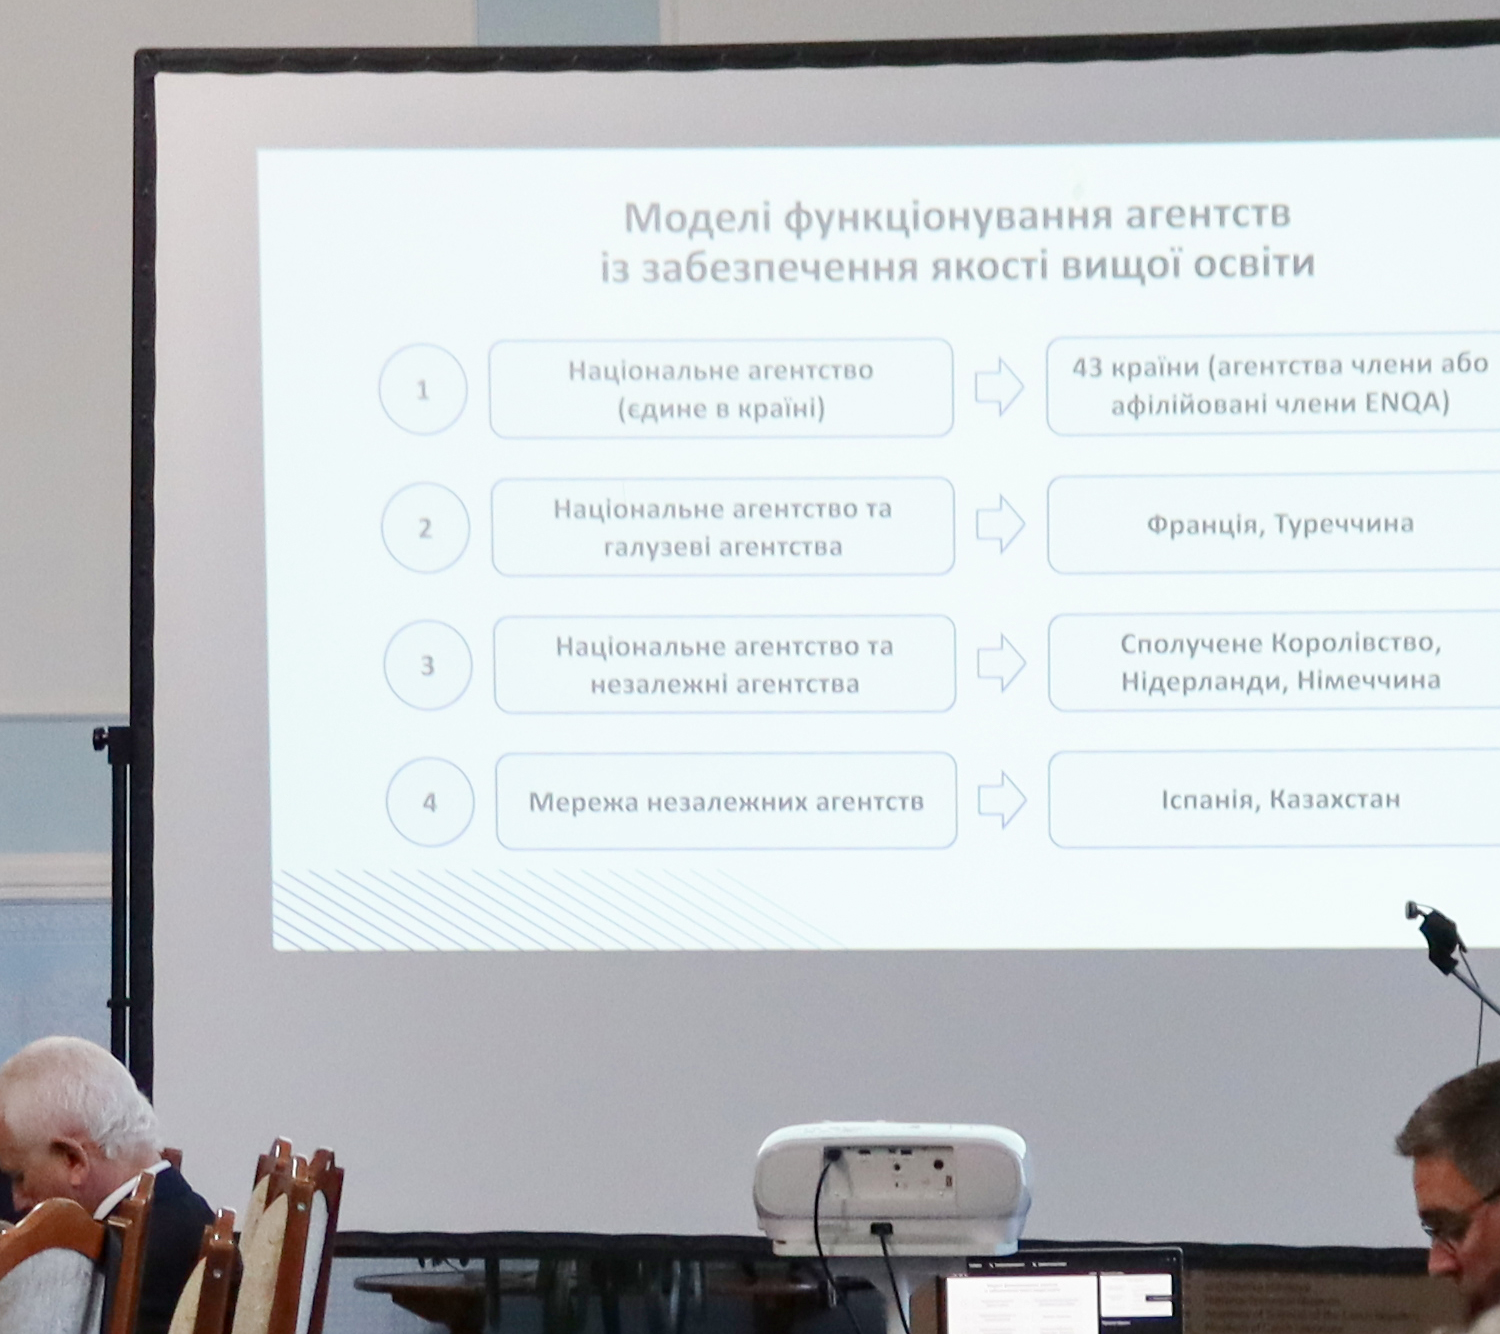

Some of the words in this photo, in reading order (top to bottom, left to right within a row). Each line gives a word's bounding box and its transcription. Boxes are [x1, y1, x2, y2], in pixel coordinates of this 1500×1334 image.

[625, 200, 771, 241] Моделі
[784, 199, 1113, 241] функціонування
[1126, 203, 1291, 230] агентств
[601, 250, 630, 284] із
[643, 249, 918, 283] забезпечення
[932, 248, 1048, 281] якості
[1062, 247, 1183, 287] вищої
[1193, 245, 1315, 279] освіти
[568, 359, 740, 386] Національне
[747, 363, 874, 381] агентство
[1072, 356, 1103, 379] 43
[1111, 354, 1199, 383] країни
[1208, 354, 1343, 382] (агентства
[1351, 358, 1433, 375] члени
[1441, 350, 1489, 374] або
[417, 379, 429, 401] 1
[617, 396, 708, 424] (єдине
[716, 403, 730, 419] в
[737, 395, 826, 424] країні)
[1111, 392, 1268, 421] афілійовані
[1275, 397, 1357, 414] члени
[1365, 389, 1450, 417] ENQA)
[553, 497, 725, 524] Національне
[732, 502, 859, 519] агентство
[866, 502, 892, 519] та
[418, 517, 432, 539] 2
[1146, 513, 1265, 541] Франція,
[1274, 513, 1414, 540] Туреччина
[603, 535, 711, 562] галузеві
[719, 540, 843, 557] агентства
[556, 635, 726, 662] Національне
[734, 639, 860, 657] агентство
[867, 639, 894, 656] та
[1120, 633, 1263, 659] Сполучене
[1271, 631, 1441, 658] Королівство,
[421, 654, 435, 677] 3
[590, 673, 729, 695] незалежні
[736, 677, 860, 695] агентства
[1122, 670, 1288, 697] Нідерланди,
[1297, 669, 1441, 691] Німеччина
[422, 792, 437, 813] 4
[529, 791, 639, 818] Мережа
[647, 795, 808, 813] незалежних
[816, 795, 925, 812] агентств
[1162, 788, 1261, 814] Іспанія,
[1270, 788, 1401, 810] Казахстан
